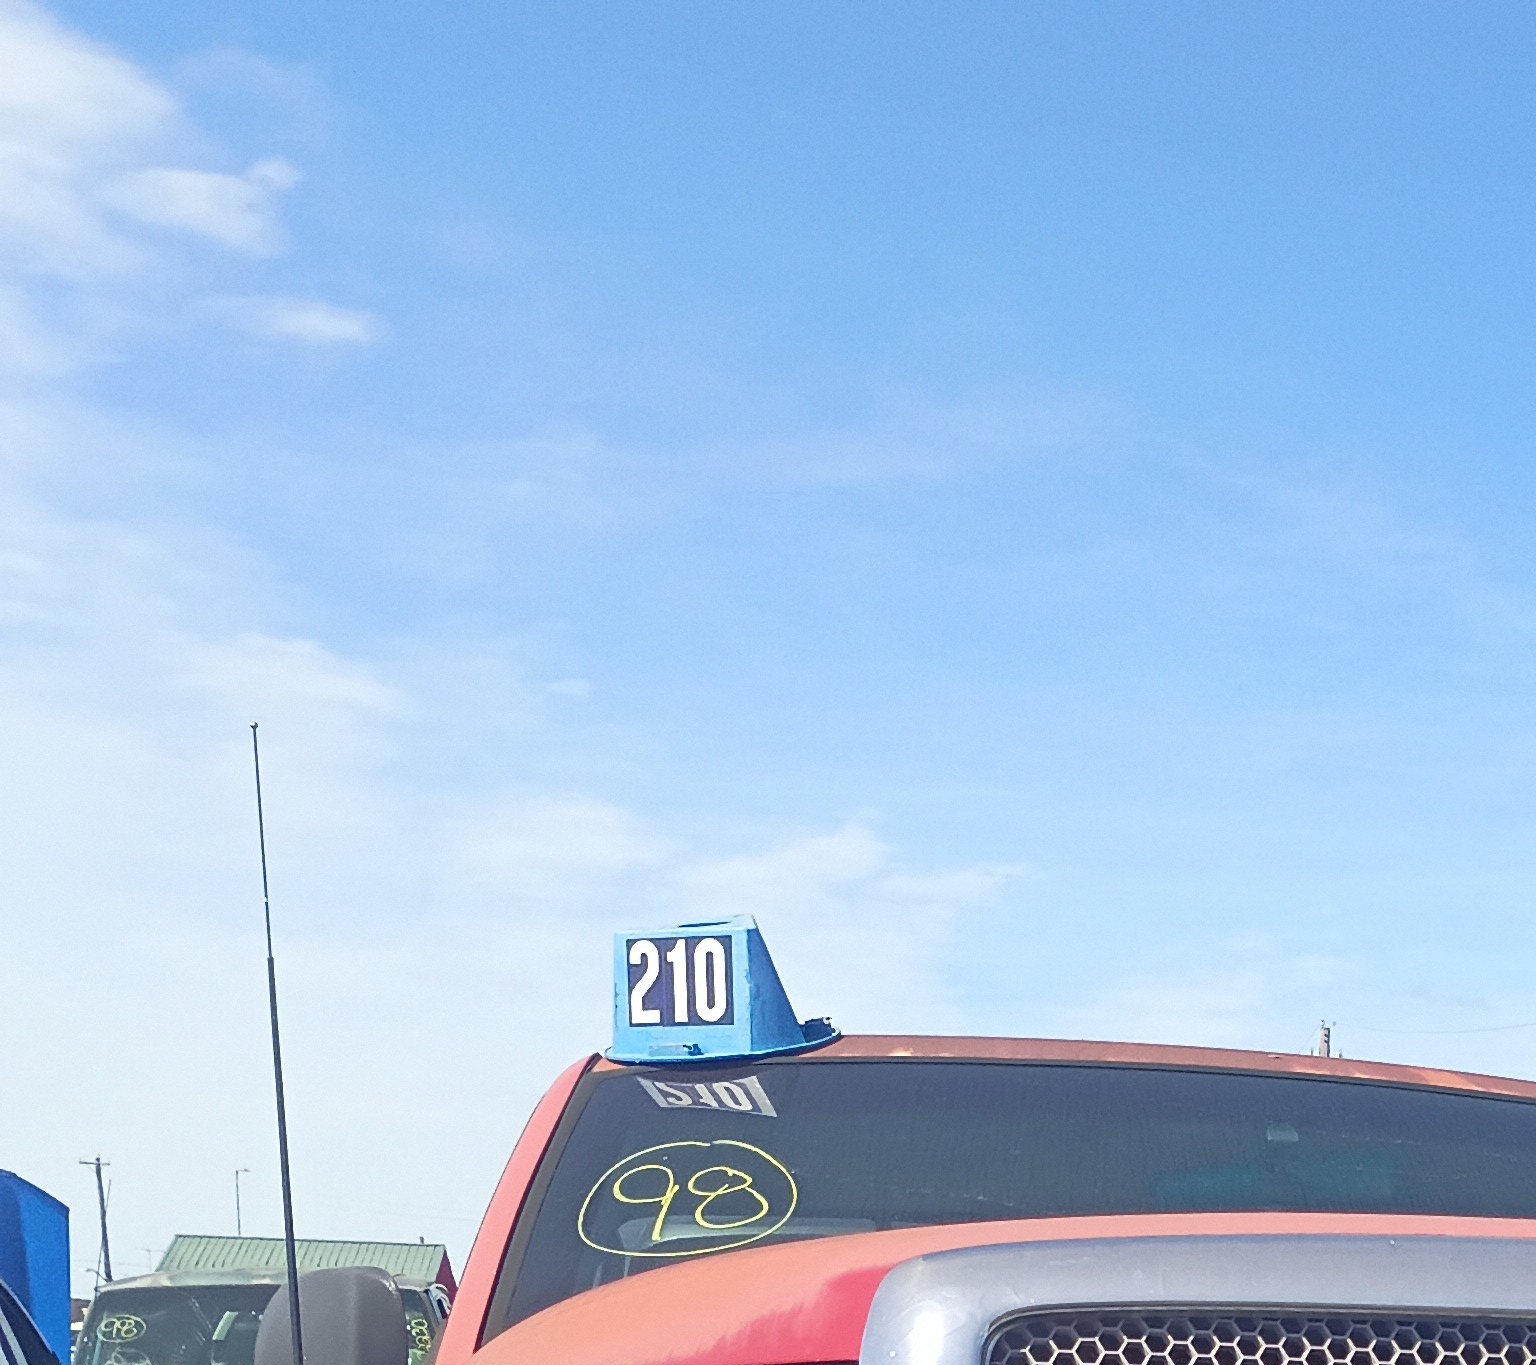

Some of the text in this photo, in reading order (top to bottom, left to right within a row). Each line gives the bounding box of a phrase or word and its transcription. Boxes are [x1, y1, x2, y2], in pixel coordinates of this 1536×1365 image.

[628, 937, 727, 1025] 210
[613, 1164, 769, 1241] 98
[101, 1318, 138, 1338] 98
